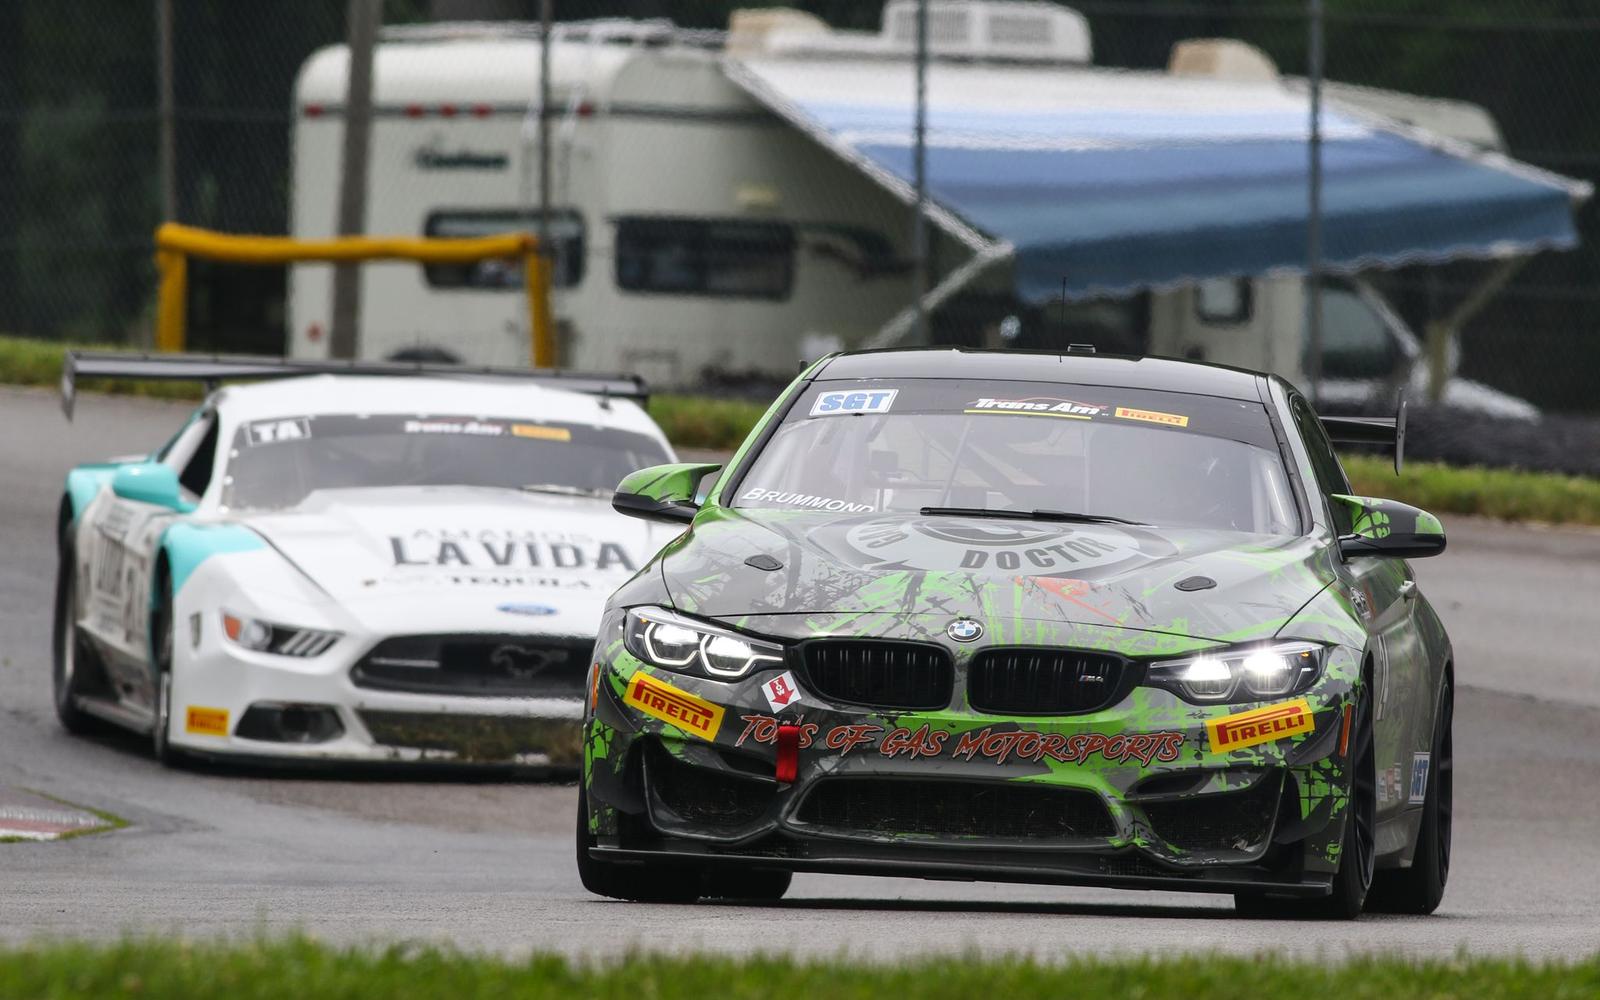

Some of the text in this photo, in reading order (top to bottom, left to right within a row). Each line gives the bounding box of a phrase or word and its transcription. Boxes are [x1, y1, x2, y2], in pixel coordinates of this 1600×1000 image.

[819, 391, 892, 411] SGT
[975, 398, 1101, 415] Trans Am
[252, 421, 302, 443] TA
[742, 487, 875, 513] BRUMMOND
[959, 536, 1118, 570] DOCTOR
[772, 679, 786, 697] TOW
[632, 679, 714, 731] PIRELLI
[1216, 706, 1305, 746] PIRELLI
[734, 713, 1185, 767] TOS OF GAS MOTORSPORTS
